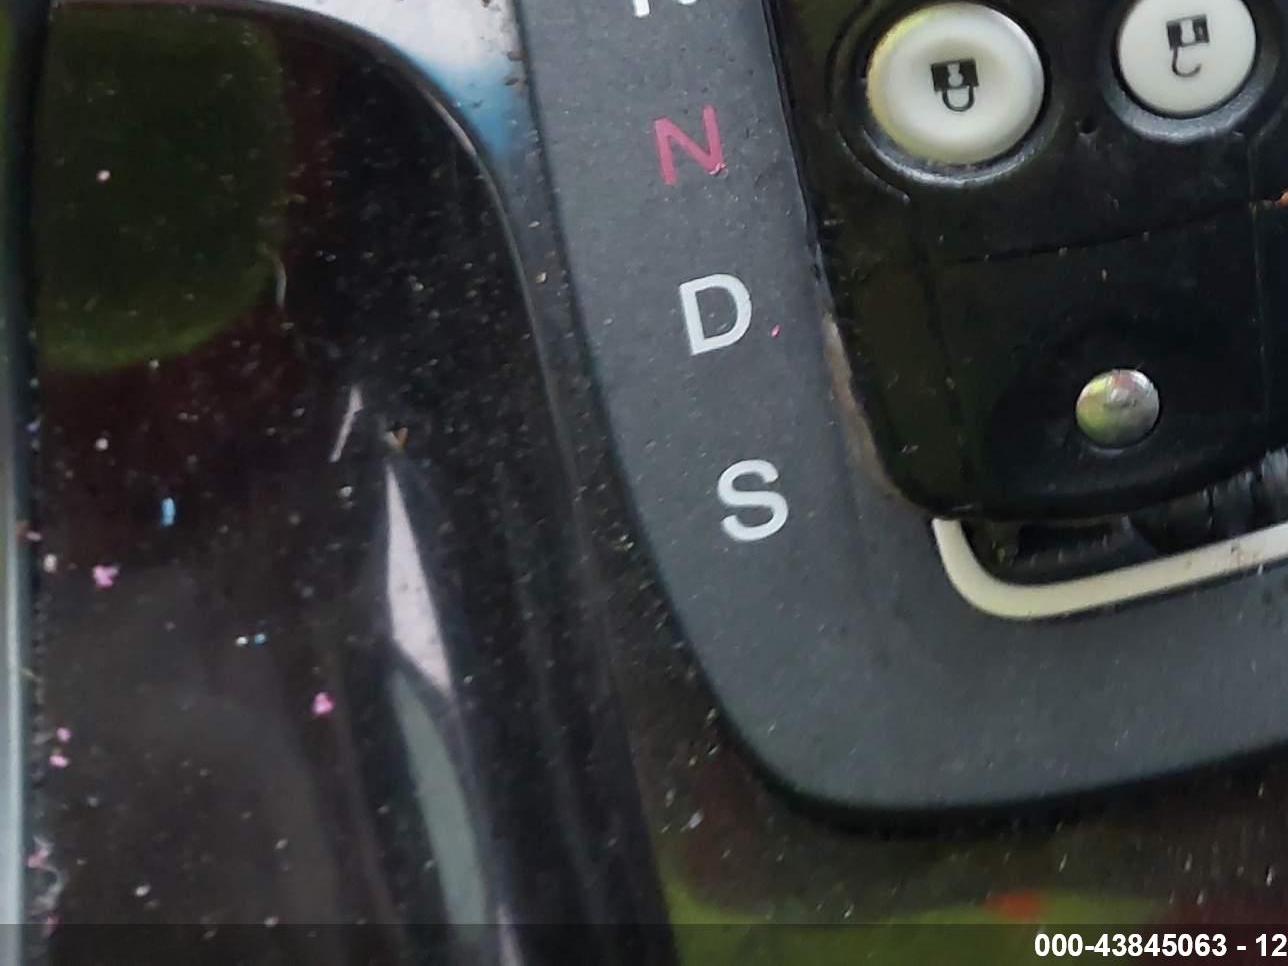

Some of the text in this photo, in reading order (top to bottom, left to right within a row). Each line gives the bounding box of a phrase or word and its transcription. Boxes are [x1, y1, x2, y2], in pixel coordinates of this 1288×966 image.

[653, 104, 727, 187] N
[679, 273, 753, 356] D
[716, 458, 789, 542] S
